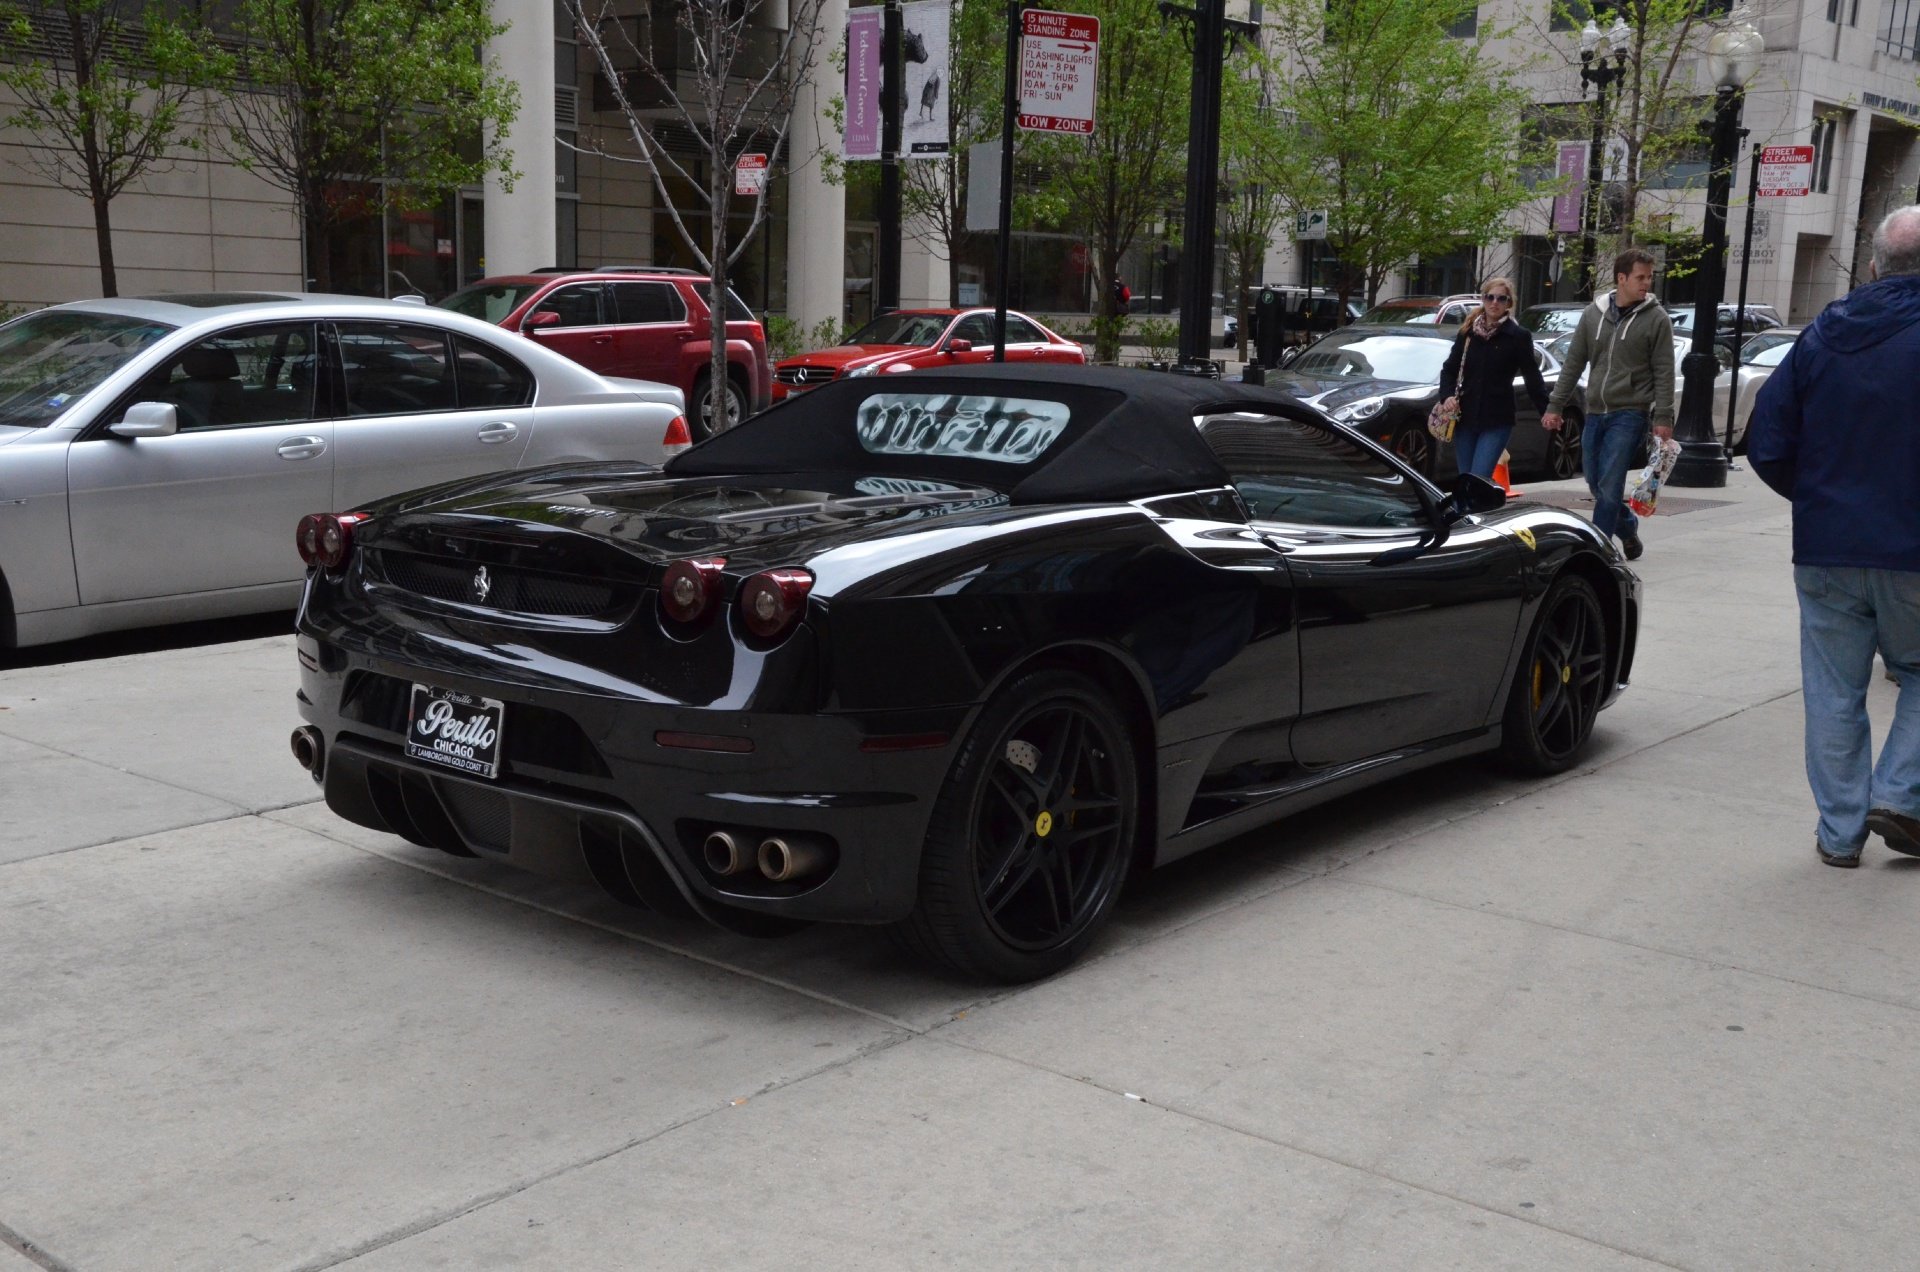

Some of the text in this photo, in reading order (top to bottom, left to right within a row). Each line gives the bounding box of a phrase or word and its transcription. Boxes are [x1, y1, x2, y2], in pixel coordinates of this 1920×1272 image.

[1028, 14, 1068, 26] 15 MINUTE
[1027, 24, 1090, 39] STANDING ZONE
[1026, 40, 1042, 49] USE
[860, 30, 869, 82] Edward
[1025, 50, 1093, 64] FLASHING LIGHTS
[1025, 60, 1034, 68] 10
[1036, 62, 1048, 70] AM
[1056, 63, 1061, 72] 8
[1064, 64, 1076, 72] PM
[1024, 70, 1042, 79] MON
[1052, 72, 1078, 82] THURS
[1024, 80, 1032, 88] 10
[1034, 81, 1046, 90] AM
[1054, 82, 1060, 91] 6
[1062, 83, 1074, 92] PM
[1024, 90, 1036, 98] FRI
[1044, 92, 1062, 100] SUN
[1023, 116, 1086, 132] TOW ZONE
[1766, 148, 1796, 156] STREET
[443, 690, 472, 704] Perillo
[417, 700, 496, 749] Perillo
[434, 739, 474, 758] CHICAGO
[418, 748, 482, 771] LAMBORGHINI GOLD COAST
